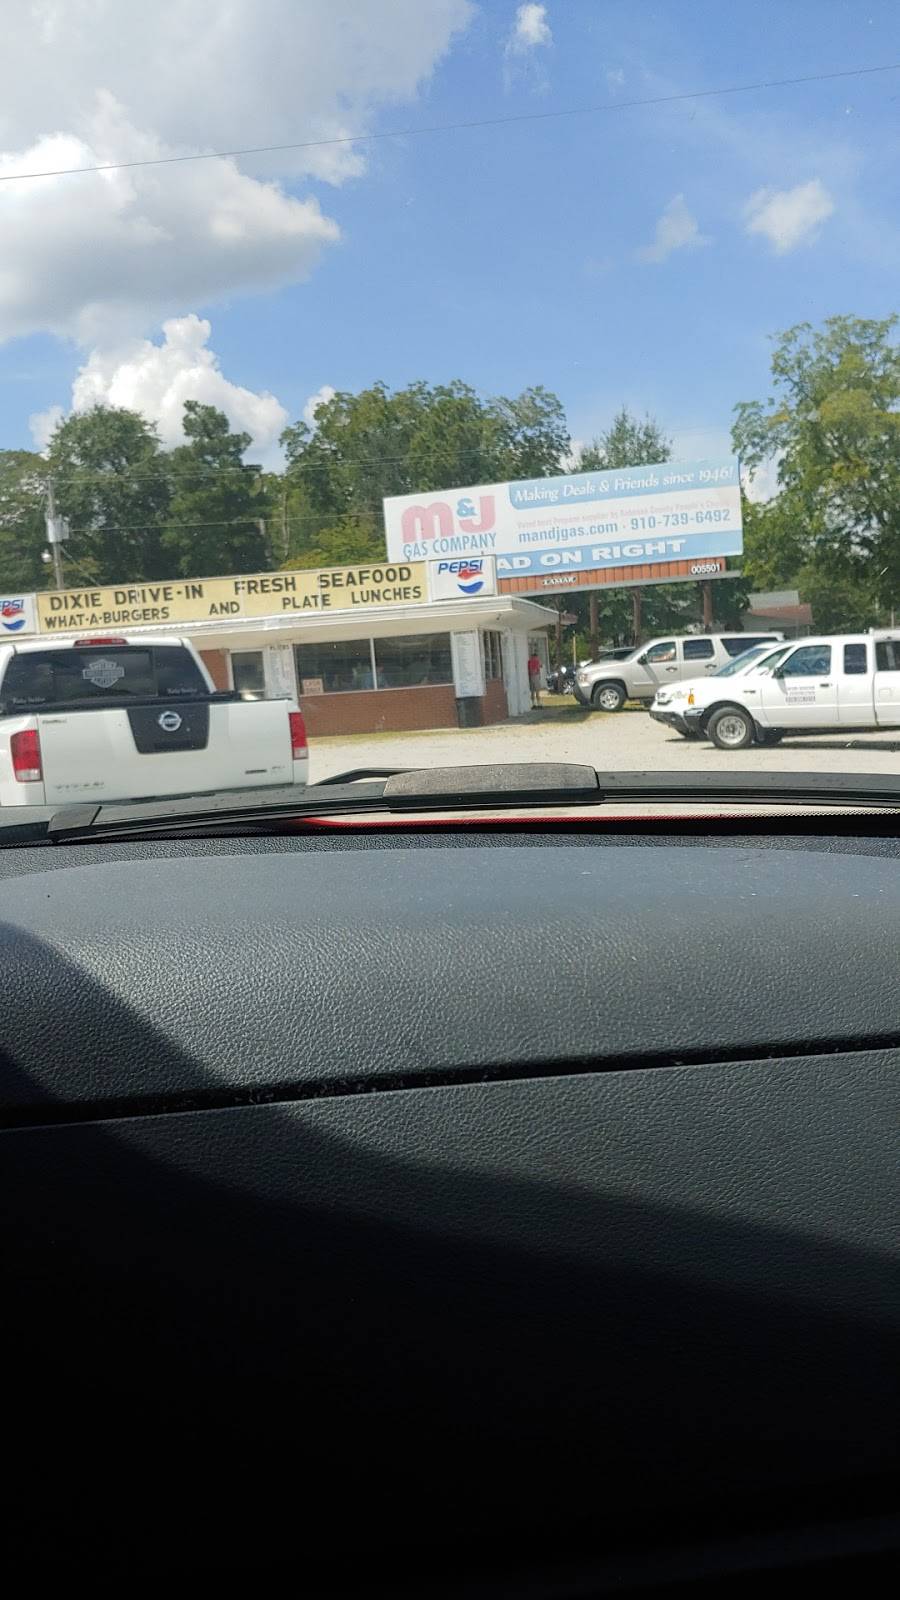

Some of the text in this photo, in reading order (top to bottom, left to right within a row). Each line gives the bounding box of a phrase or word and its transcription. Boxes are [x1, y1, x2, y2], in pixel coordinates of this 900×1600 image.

[515, 466, 734, 502] Making Deals & Friends since 1946!
[518, 509, 731, 543] mandjgas.com 910-739-6492
[403, 533, 497, 558] GAS COMPANY
[497, 539, 686, 570] AD ON RIGHT
[438, 559, 484, 575] PEPSI
[691, 562, 721, 575] 005501
[50, 566, 412, 610] DIXIE DRIVE-IN FRESH SEAFOOD
[44, 585, 422, 629] WHAT-A-BURGERS AND PLATE LUNCHES
